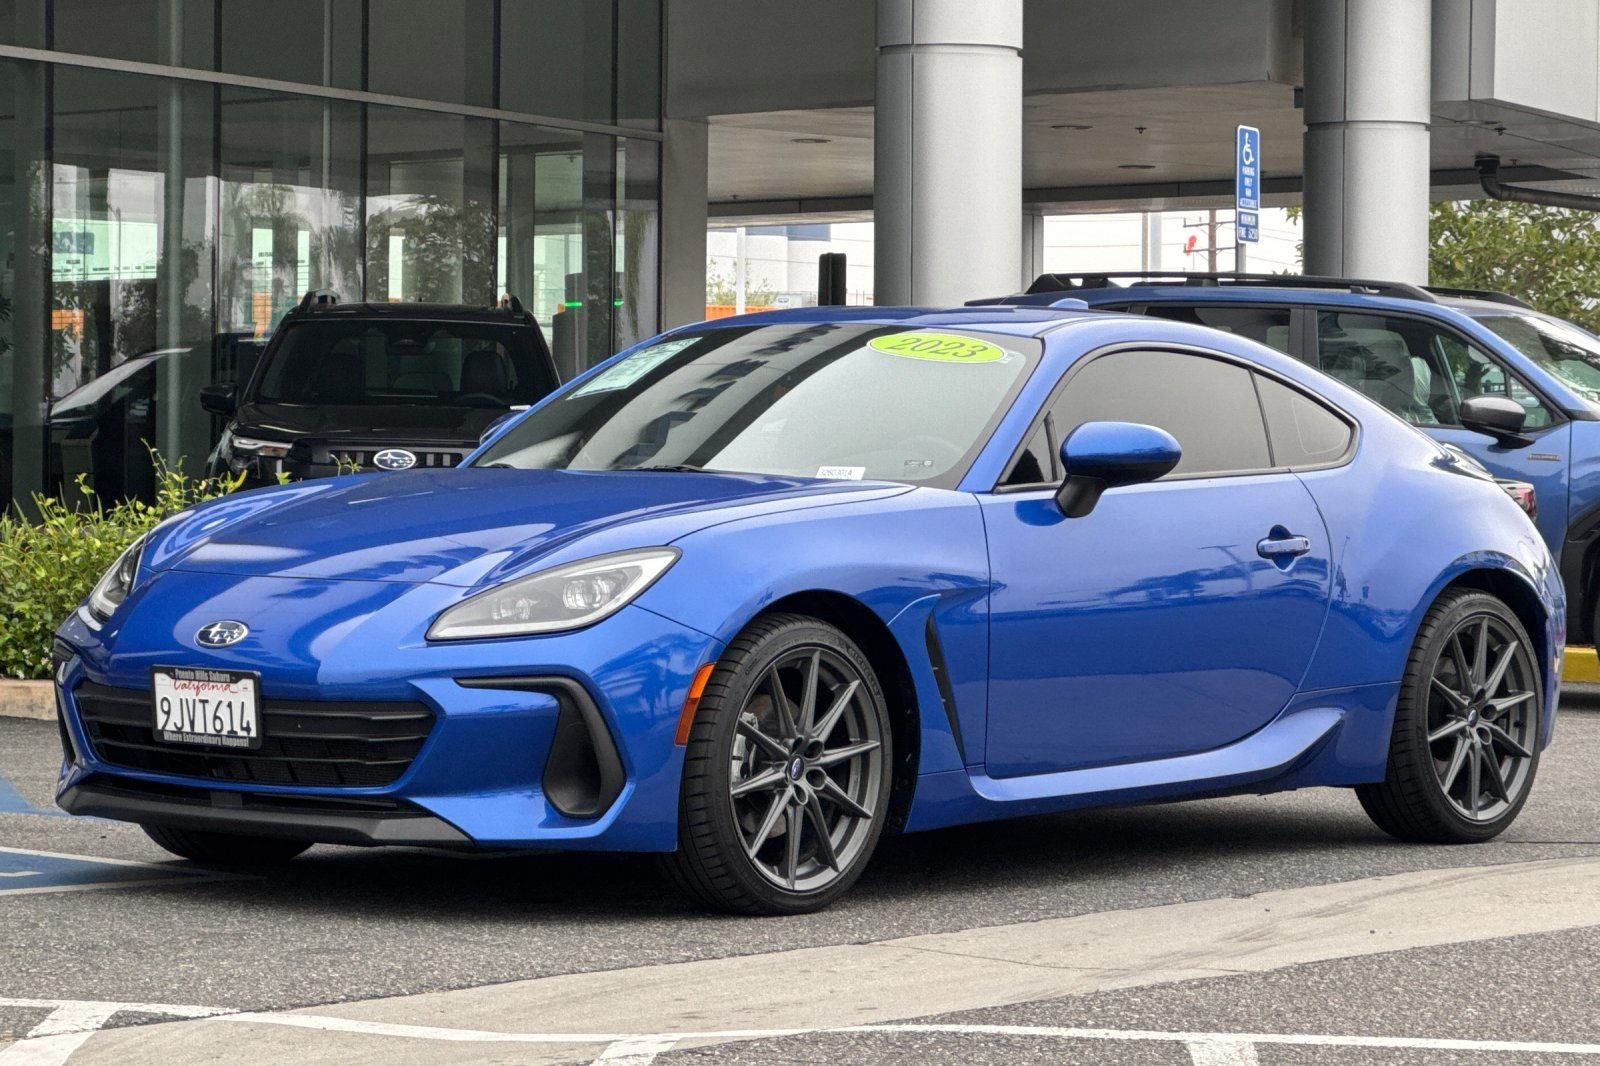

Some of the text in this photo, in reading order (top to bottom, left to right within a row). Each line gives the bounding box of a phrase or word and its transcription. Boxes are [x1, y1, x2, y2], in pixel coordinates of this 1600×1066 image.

[885, 337, 988, 358] 2023
[173, 680, 238, 697] California
[160, 696, 252, 736] 9JVT614
